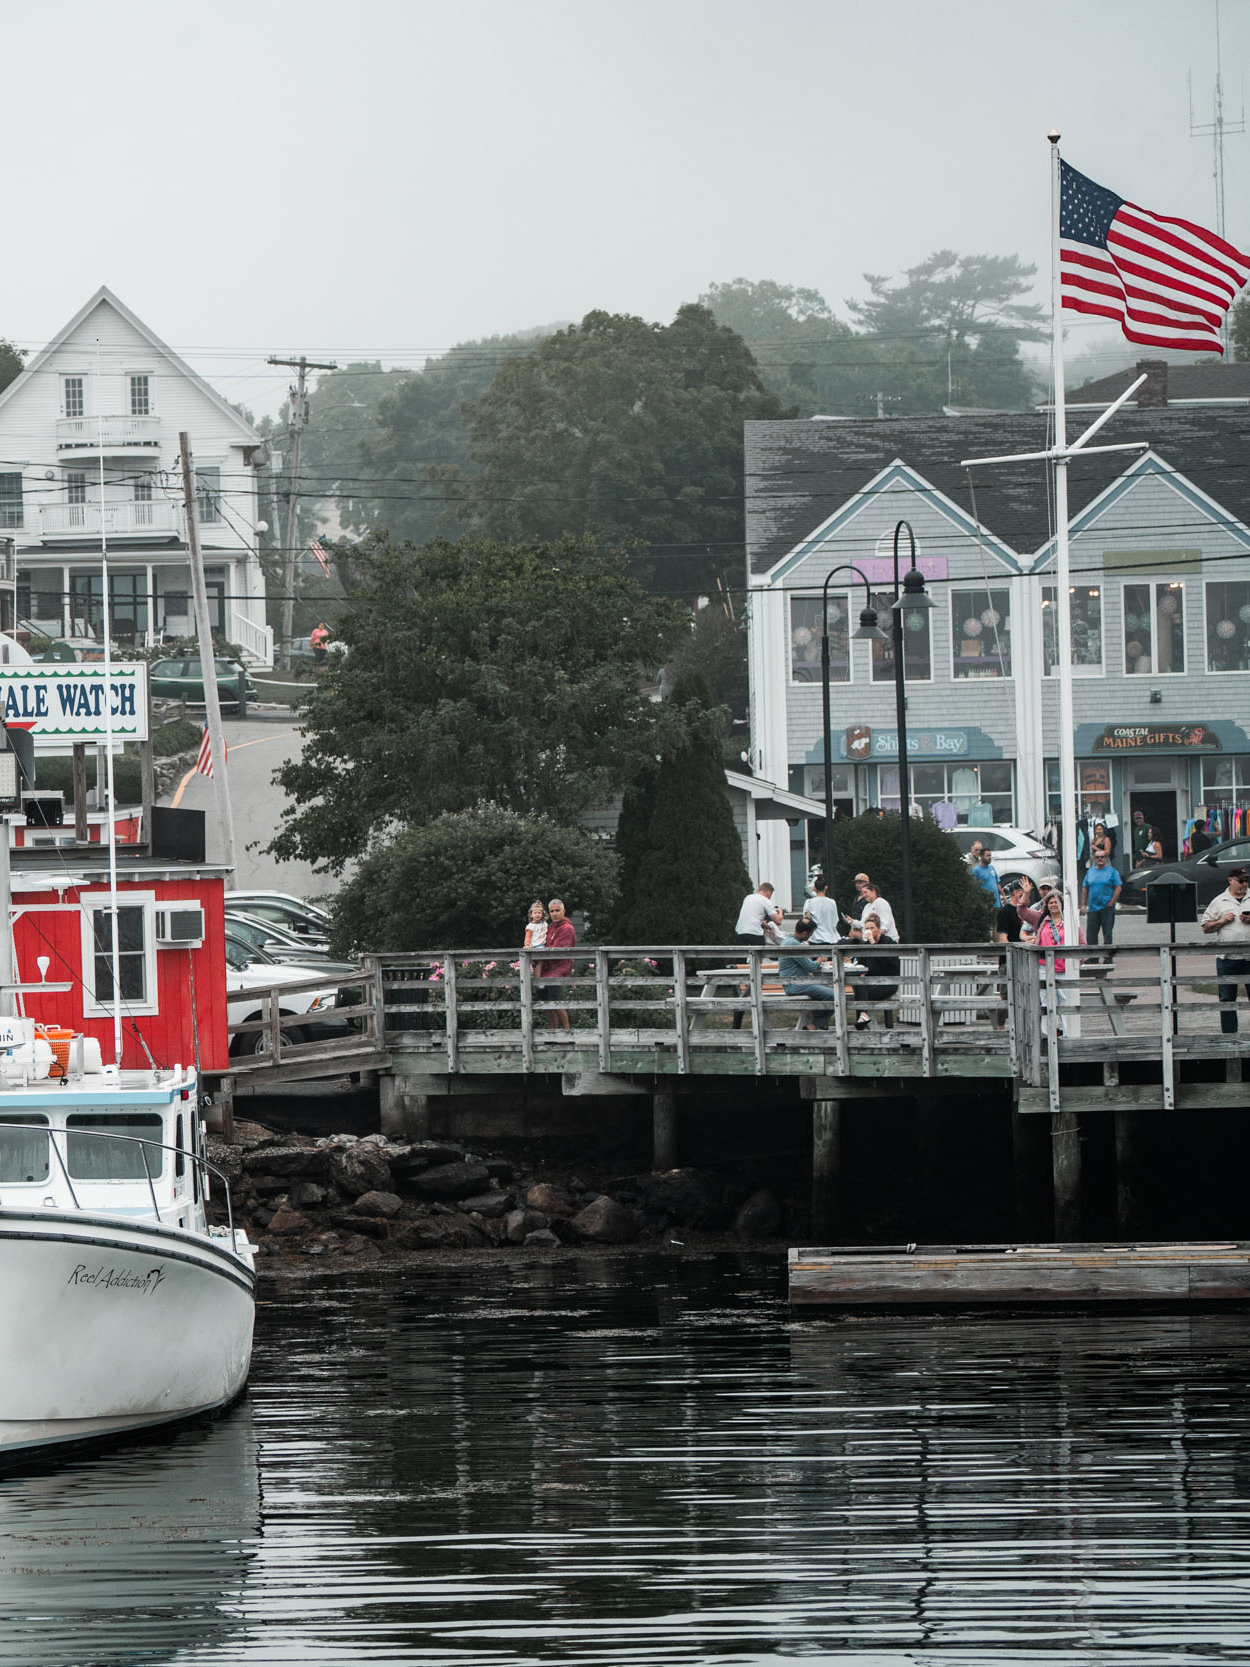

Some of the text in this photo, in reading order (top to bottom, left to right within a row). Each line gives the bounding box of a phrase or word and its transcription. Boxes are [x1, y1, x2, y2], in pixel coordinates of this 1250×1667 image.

[56, 683, 136, 717] WATCH
[1103, 733, 1183, 748] MAINE GIFTS
[1113, 727, 1150, 738] COASTAL
[876, 735, 919, 752] Shits
[935, 734, 964, 753] Bay
[67, 1264, 152, 1295] Reel Addiction
